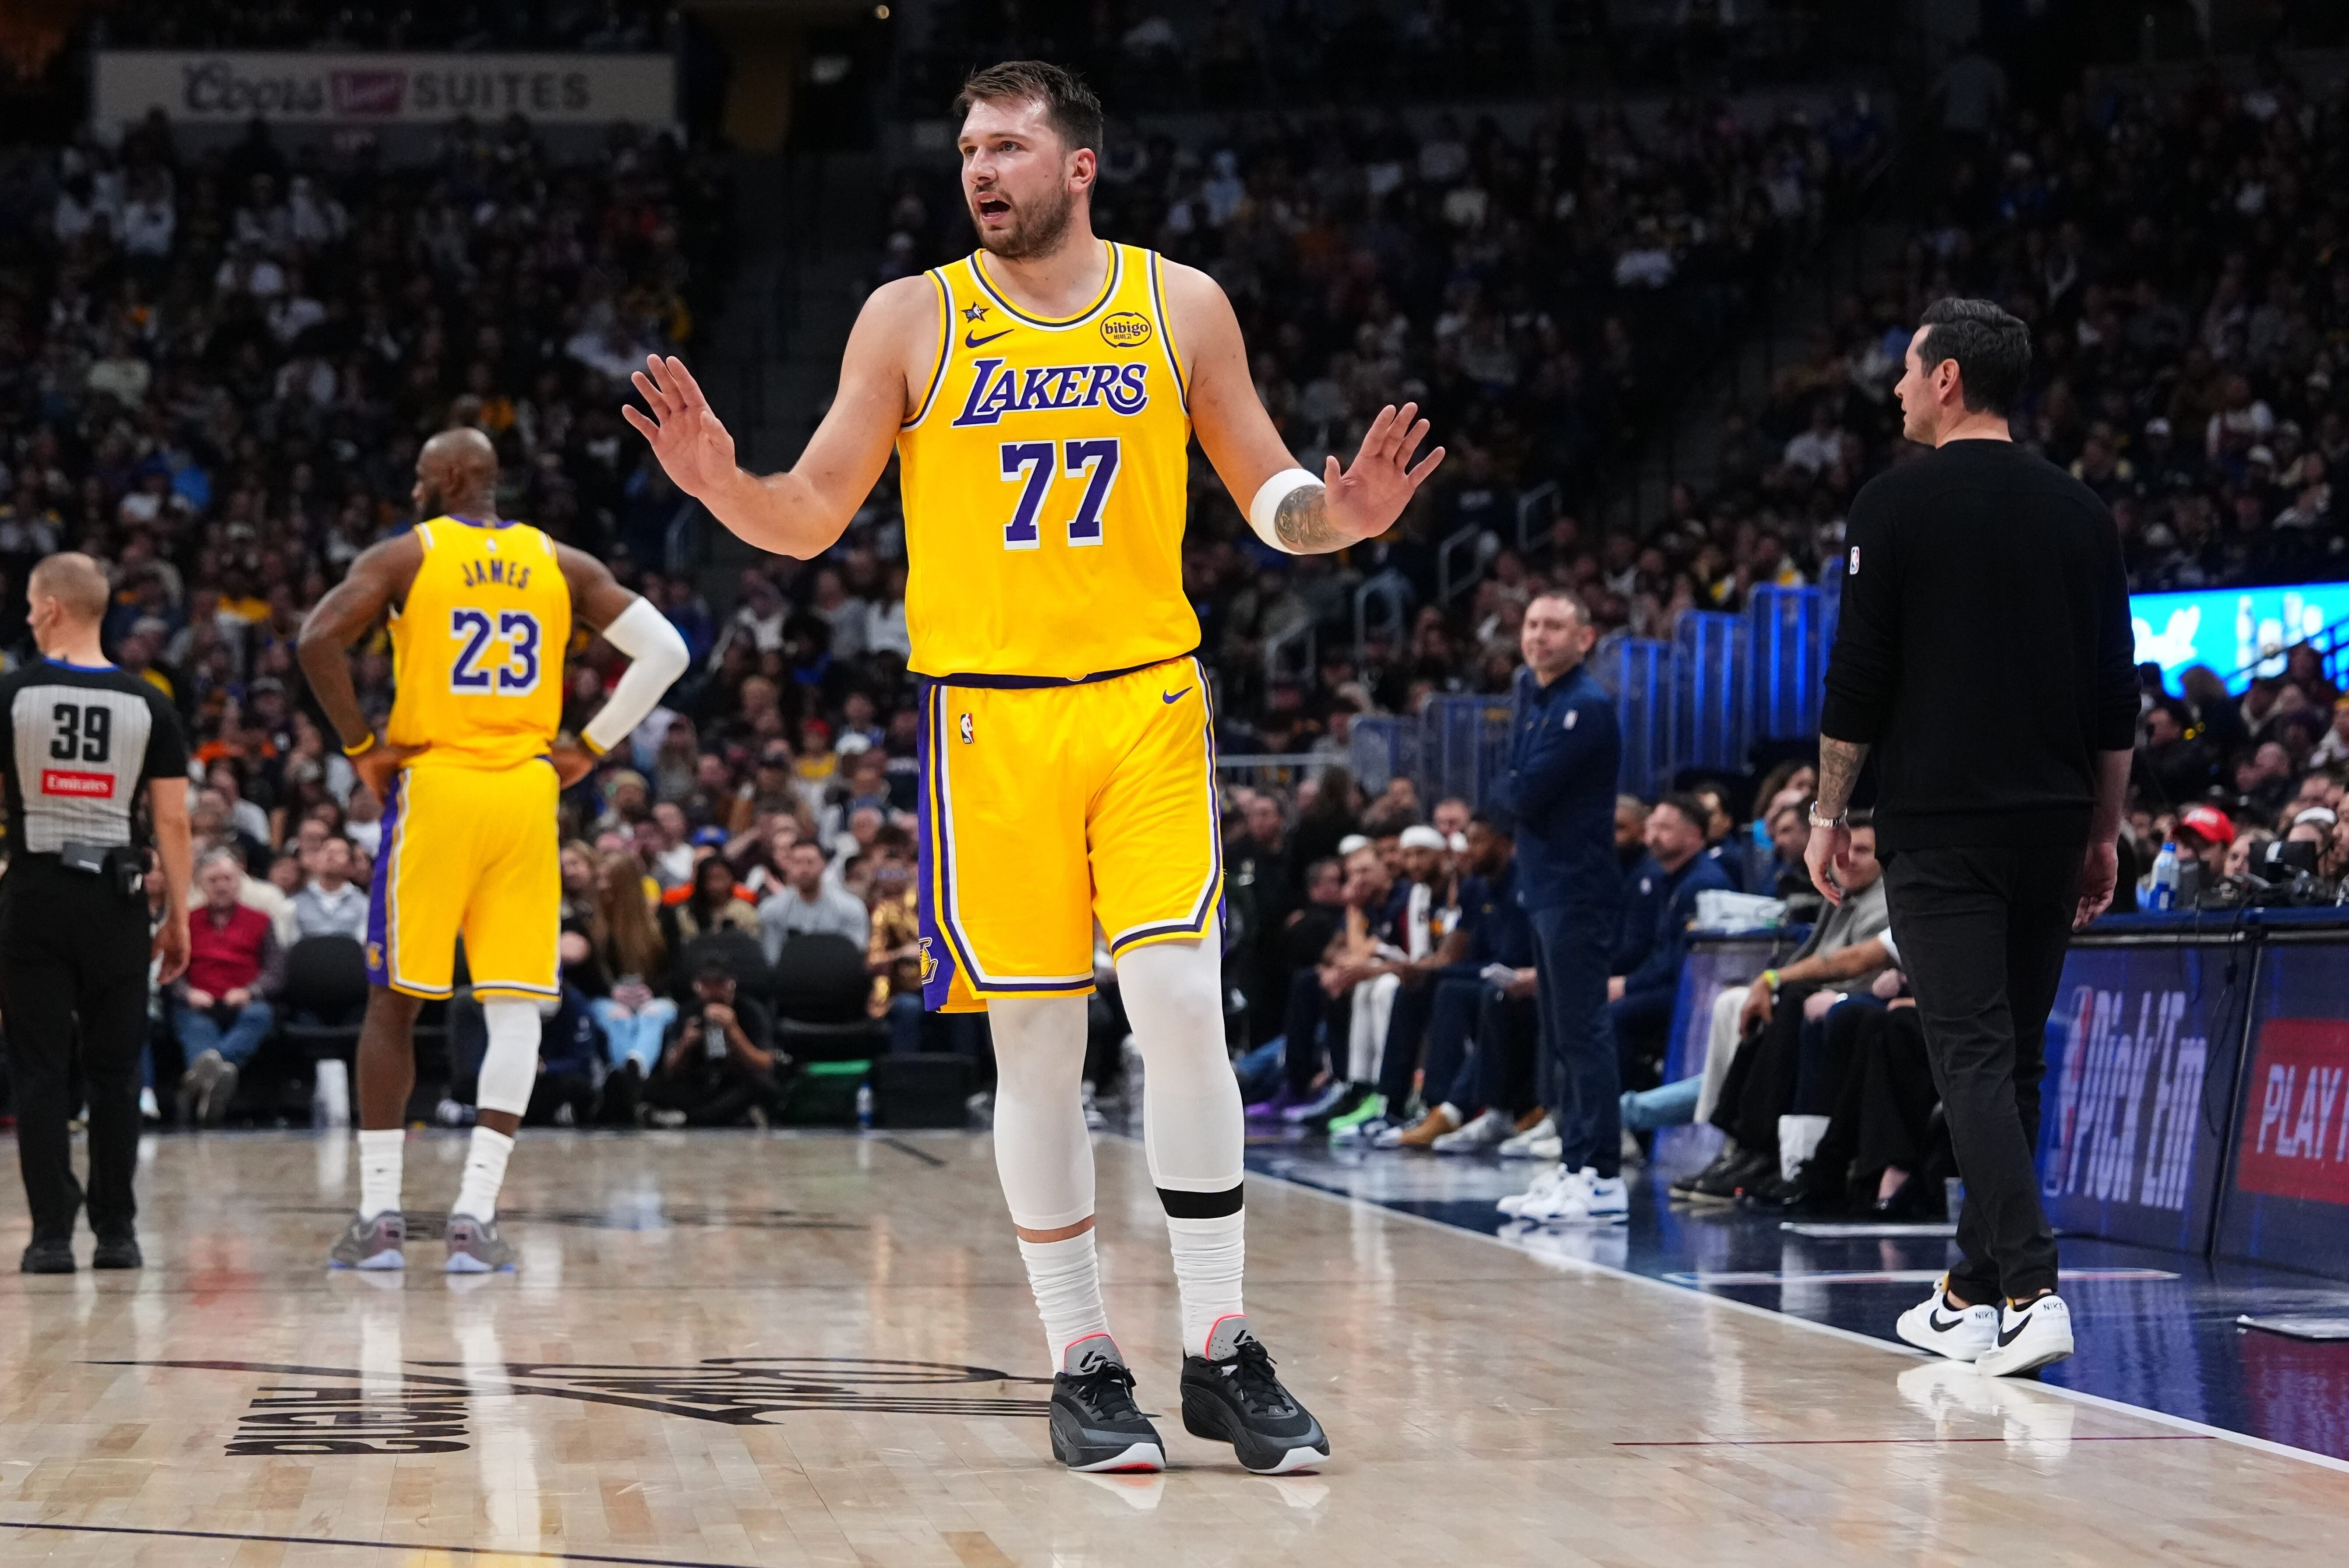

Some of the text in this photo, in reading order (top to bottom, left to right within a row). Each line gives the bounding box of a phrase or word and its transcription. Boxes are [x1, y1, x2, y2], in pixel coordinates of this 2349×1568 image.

[413, 71, 590, 111] SUITES
[1105, 321, 1148, 336] bibigo
[950, 357, 1150, 429] LAKERS
[999, 436, 1121, 551] 77
[462, 559, 531, 590] JAMES
[450, 607, 542, 697] 23
[50, 704, 110, 763] 39
[2257, 1063, 2342, 1160] PLAY
[1975, 1311, 1996, 1320] NIKE
[2043, 1302, 2064, 1312] NIKE
[224, 1386, 504, 1456] Arena
